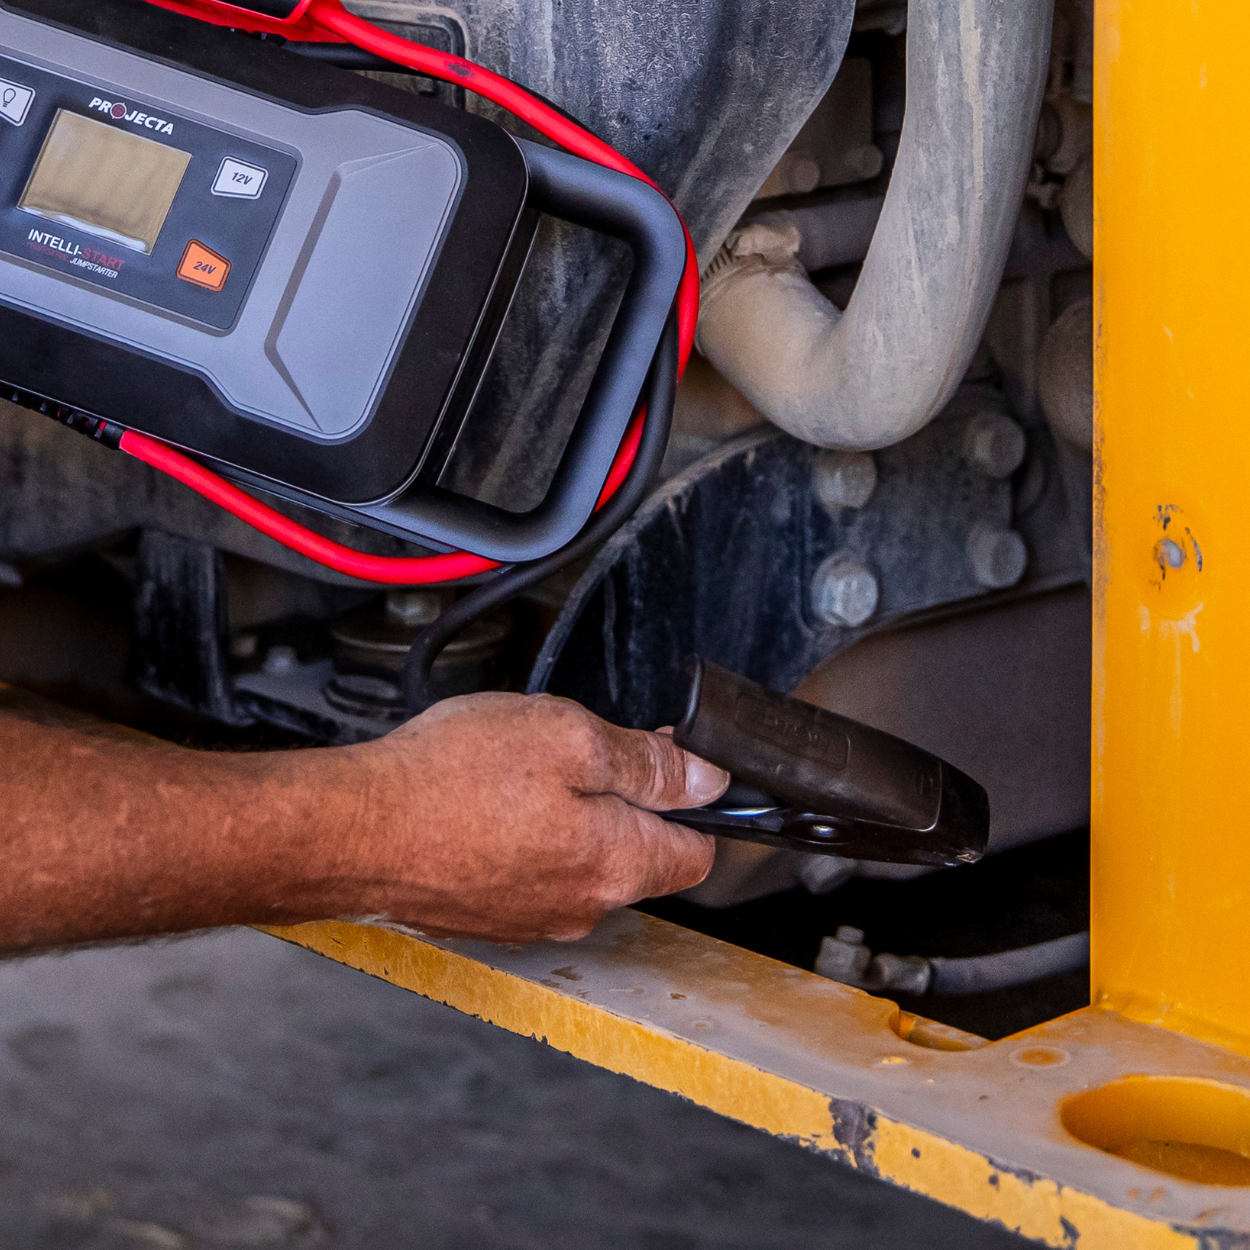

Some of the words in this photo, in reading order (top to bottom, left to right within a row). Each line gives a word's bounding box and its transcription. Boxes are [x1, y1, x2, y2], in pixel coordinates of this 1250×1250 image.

[88, 97, 174, 135] PROJECTA
[231, 172, 253, 185] 12V
[28, 229, 125, 271] INTELLI-START
[70, 258, 118, 279] JUMPSTARTER
[193, 261, 217, 275] 24V
